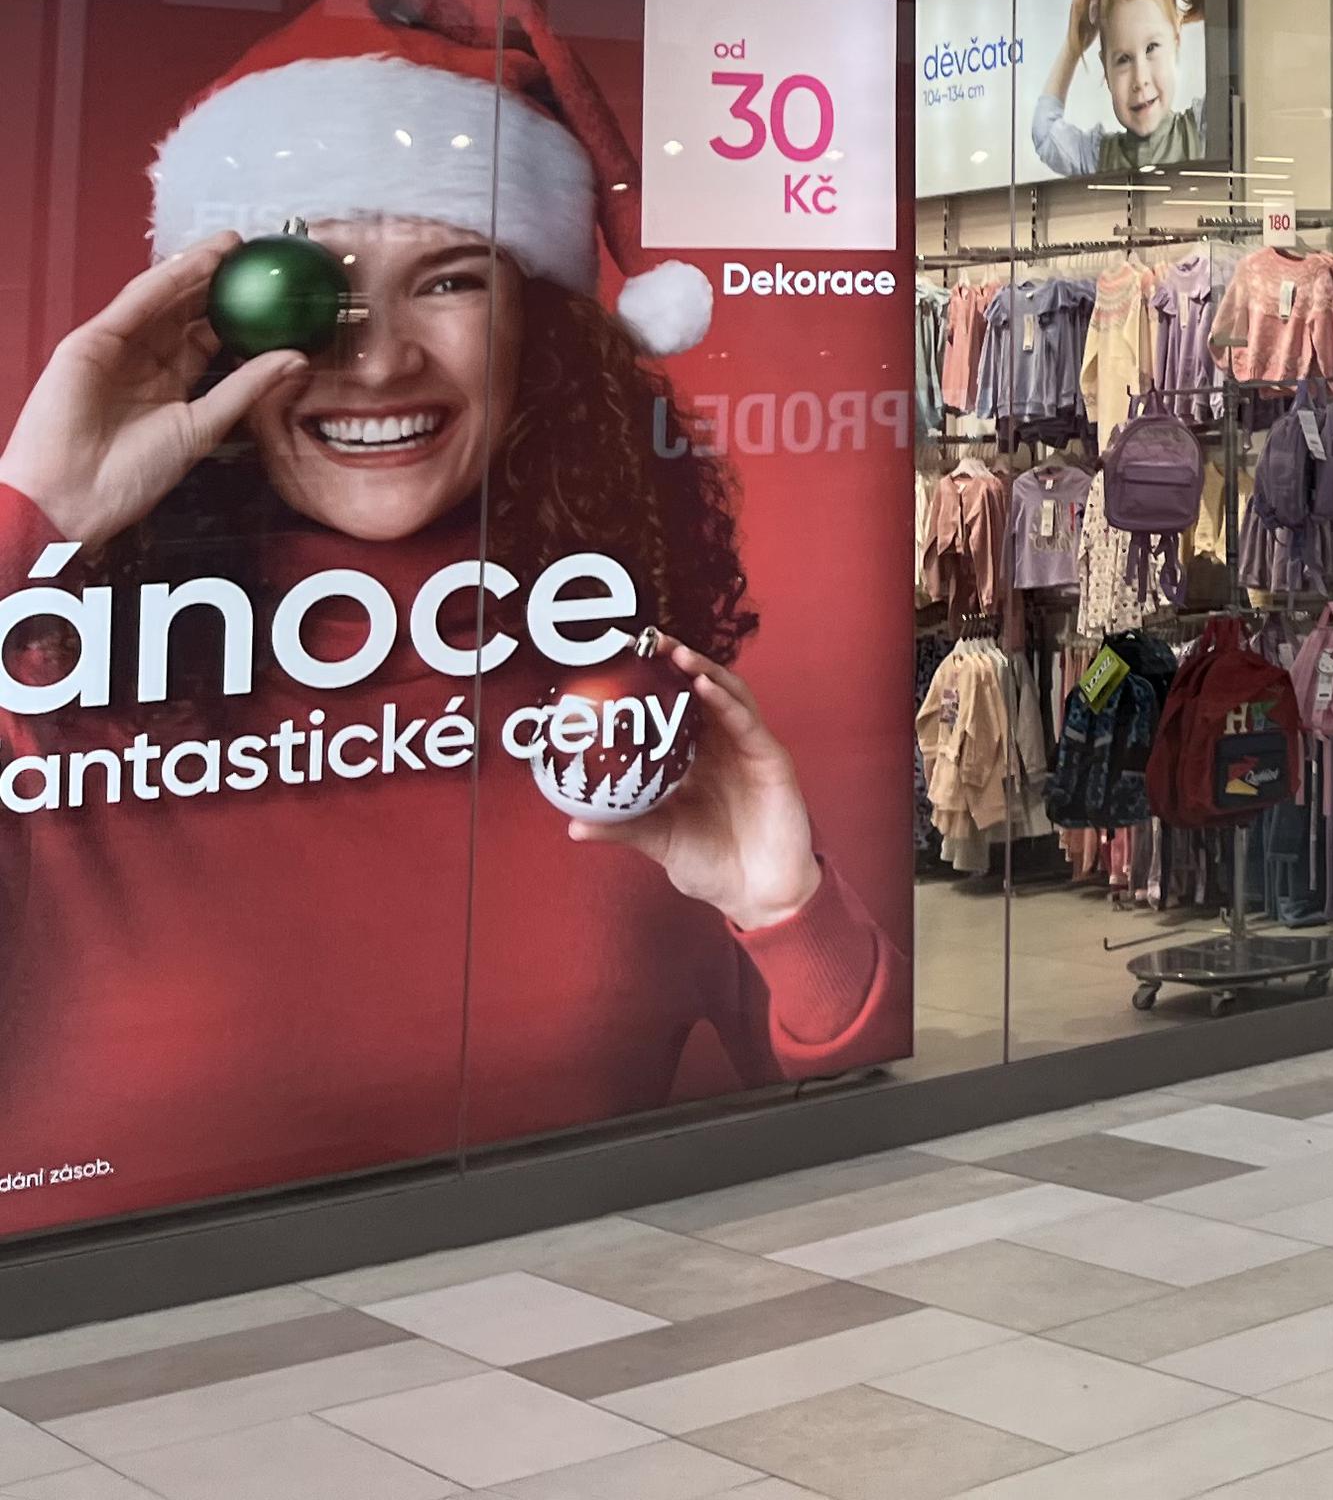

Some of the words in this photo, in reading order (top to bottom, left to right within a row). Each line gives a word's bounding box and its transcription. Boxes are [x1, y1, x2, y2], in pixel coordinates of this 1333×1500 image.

[713, 38, 746, 60] od
[923, 35, 1025, 81] děvčata
[967, 83, 985, 100] cm
[708, 70, 835, 162] 30
[783, 173, 838, 215] Kč
[1268, 213, 1291, 231] 180
[722, 261, 897, 297] Dekorace
[0, 542, 638, 715] ánoce
[0, 696, 476, 814] antastické
[501, 691, 690, 762] ceny
[0, 1167, 44, 1193] dání
[49, 1158, 115, 1185] zásob.
